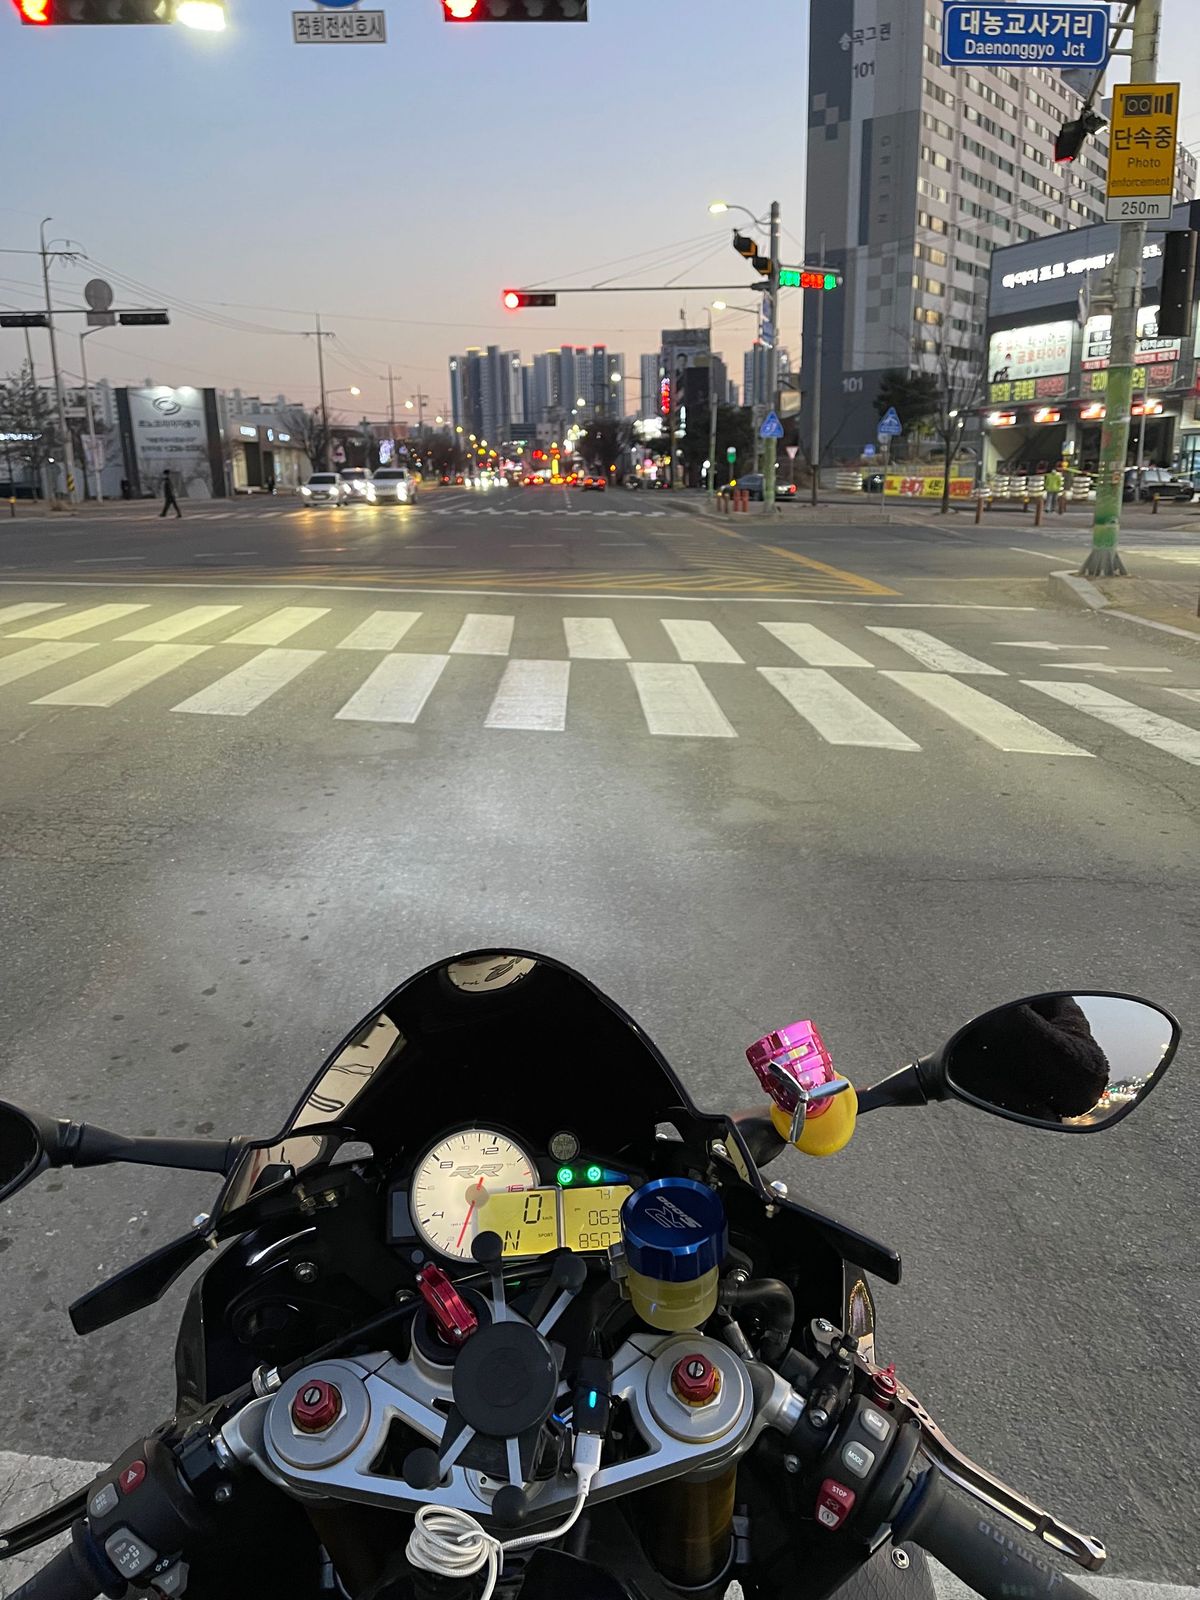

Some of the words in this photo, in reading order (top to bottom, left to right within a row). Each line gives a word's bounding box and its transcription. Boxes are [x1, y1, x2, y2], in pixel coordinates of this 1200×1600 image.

[297, 16, 383, 39] 좌회전신호시
[960, 10, 1092, 39] 대농교사거리
[965, 39, 1055, 59] Daenonggyo
[1062, 41, 1085, 57] Jct
[853, 61, 875, 78] 101
[1114, 126, 1172, 150] 단속중
[1127, 157, 1161, 168] Photo
[1110, 176, 1170, 188] enforcement
[1121, 202, 1159, 215] 250m
[842, 377, 863, 392] 101
[481, 1147, 499, 1155] 12
[505, 1184, 524, 1192] 16
[523, 1194, 542, 1224] 0
[504, 1230, 520, 1251] N
[848, 1450, 864, 1466] MODE
[832, 1485, 847, 1498] STOP
[129, 1559, 140, 1570] SET
